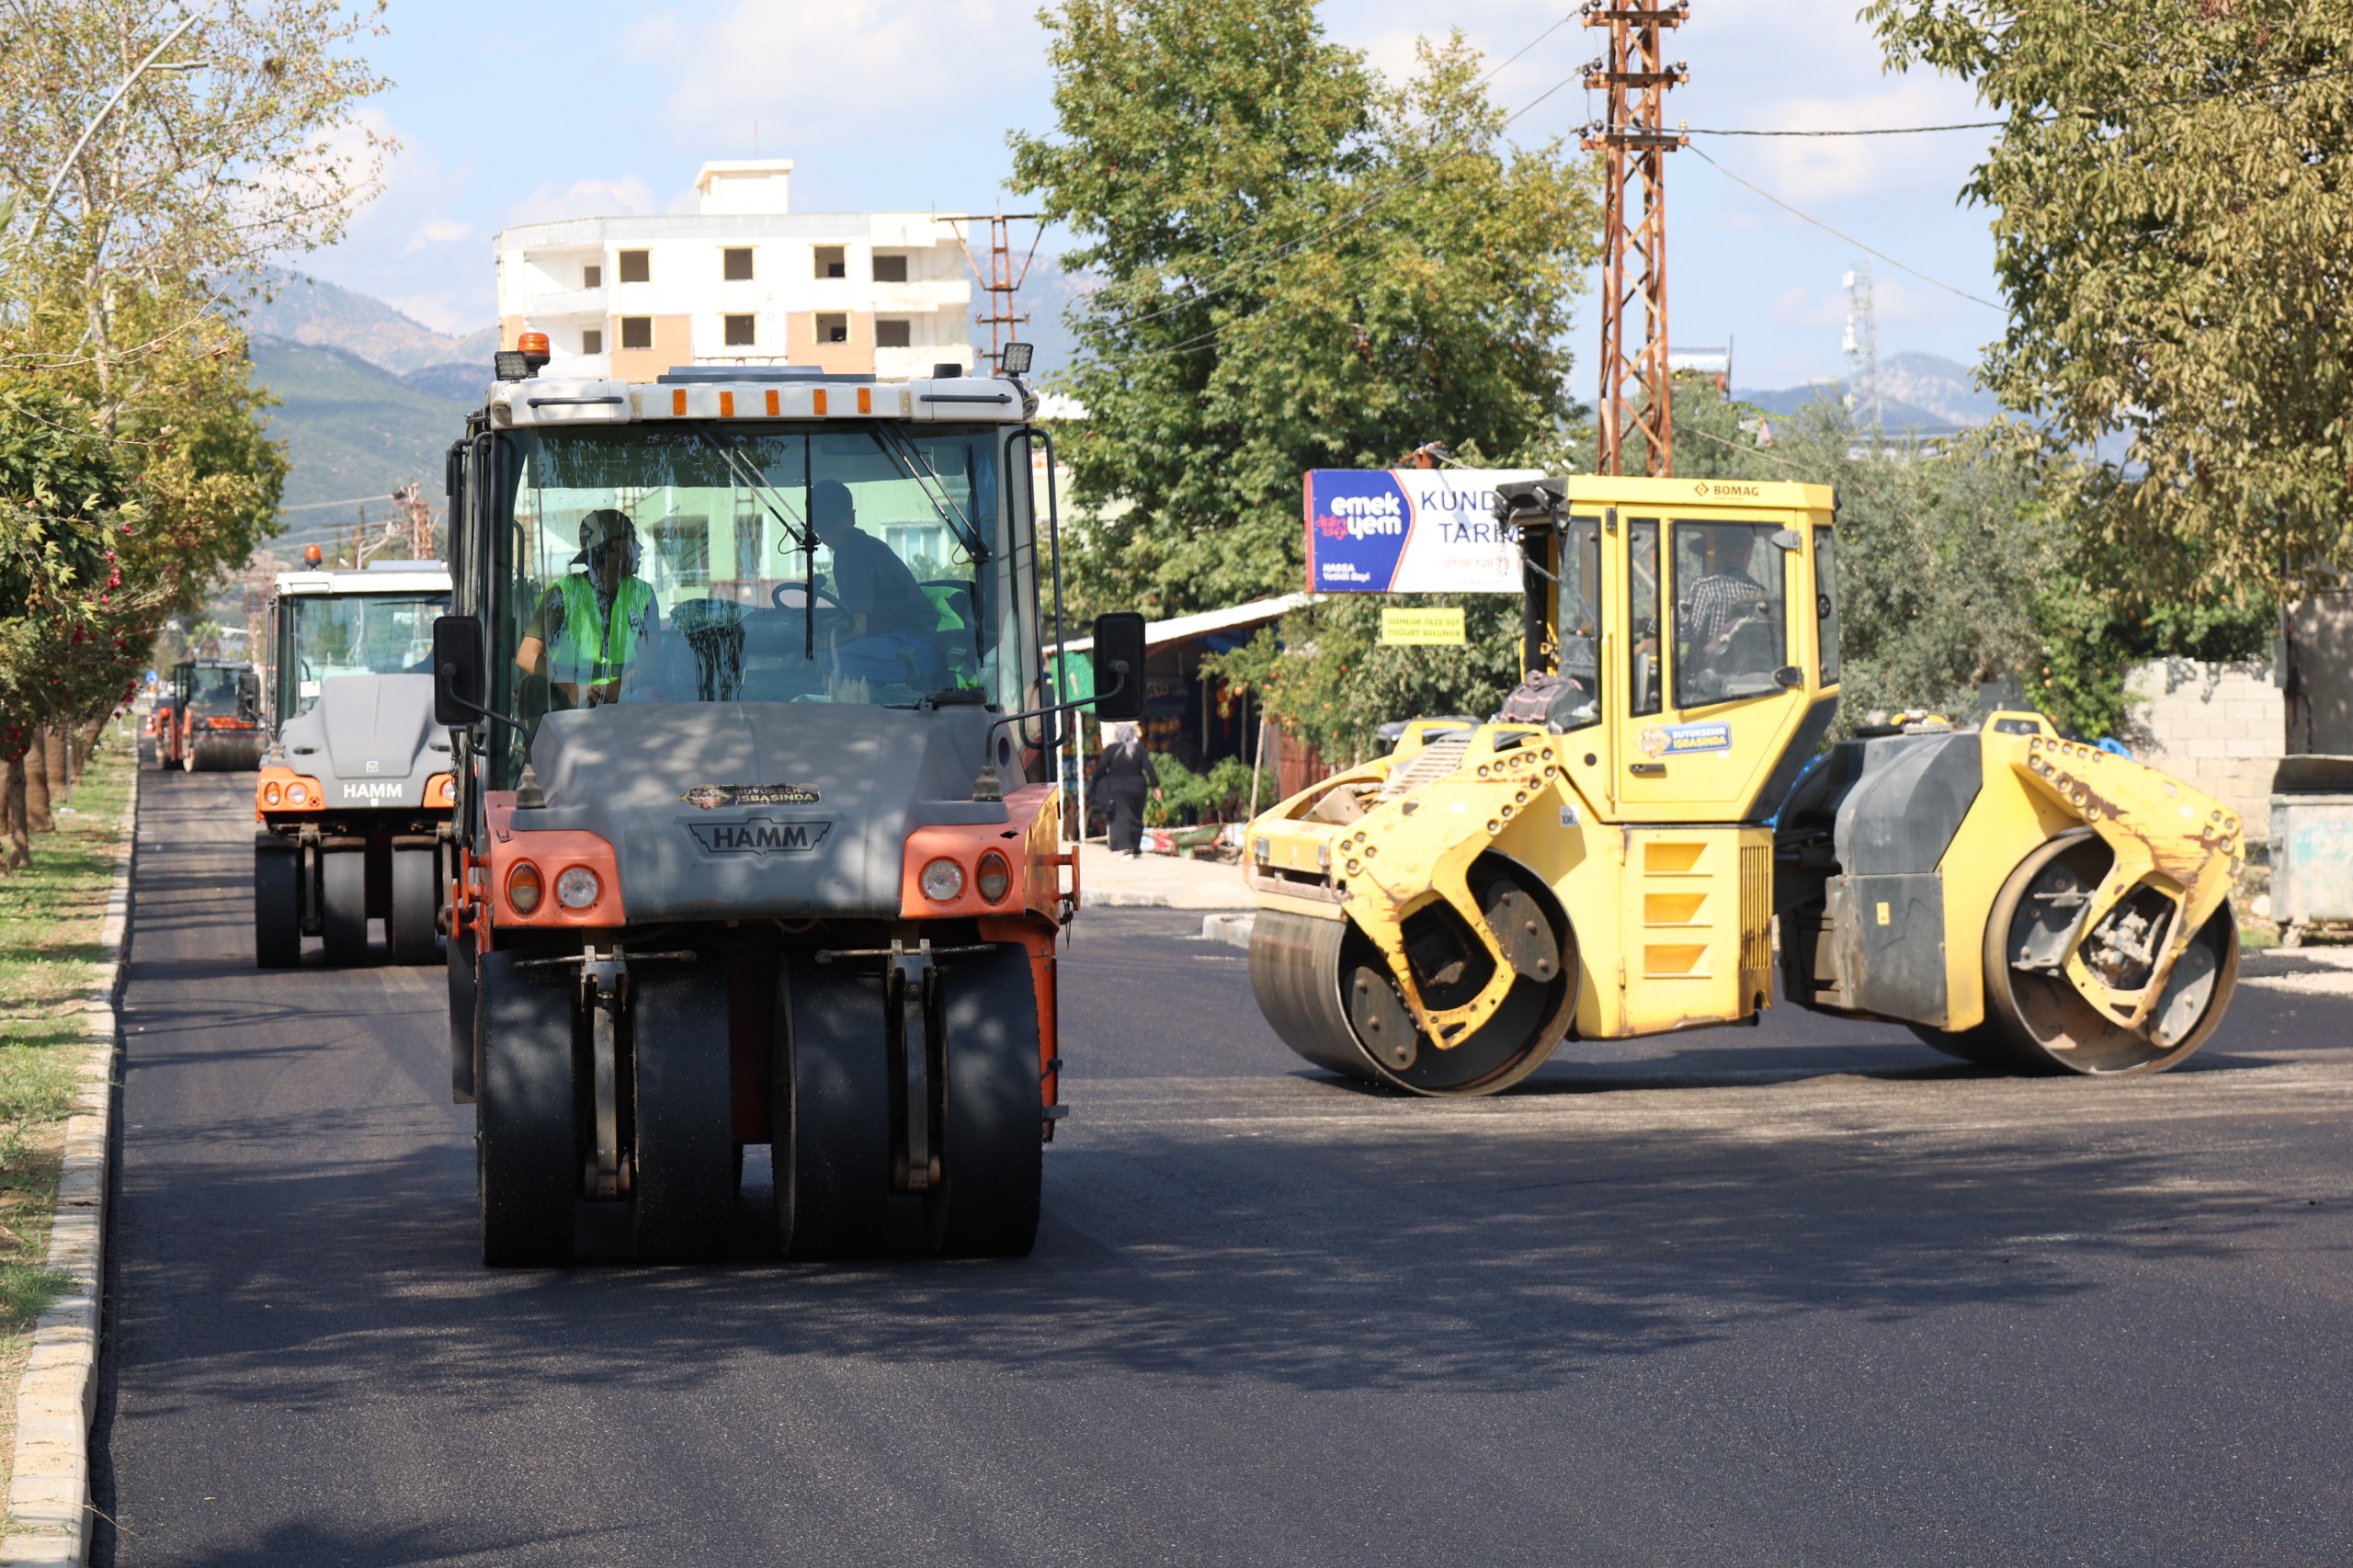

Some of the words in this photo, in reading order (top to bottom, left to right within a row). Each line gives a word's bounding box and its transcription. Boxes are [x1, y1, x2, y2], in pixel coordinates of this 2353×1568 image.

[1713, 485, 1759, 496] BOMAG
[1330, 491, 1402, 516] emek
[1347, 515, 1403, 540] yem
[1323, 562, 1357, 572] HASSA
[344, 783, 403, 799] HAMM
[713, 825, 808, 848] HAMM
